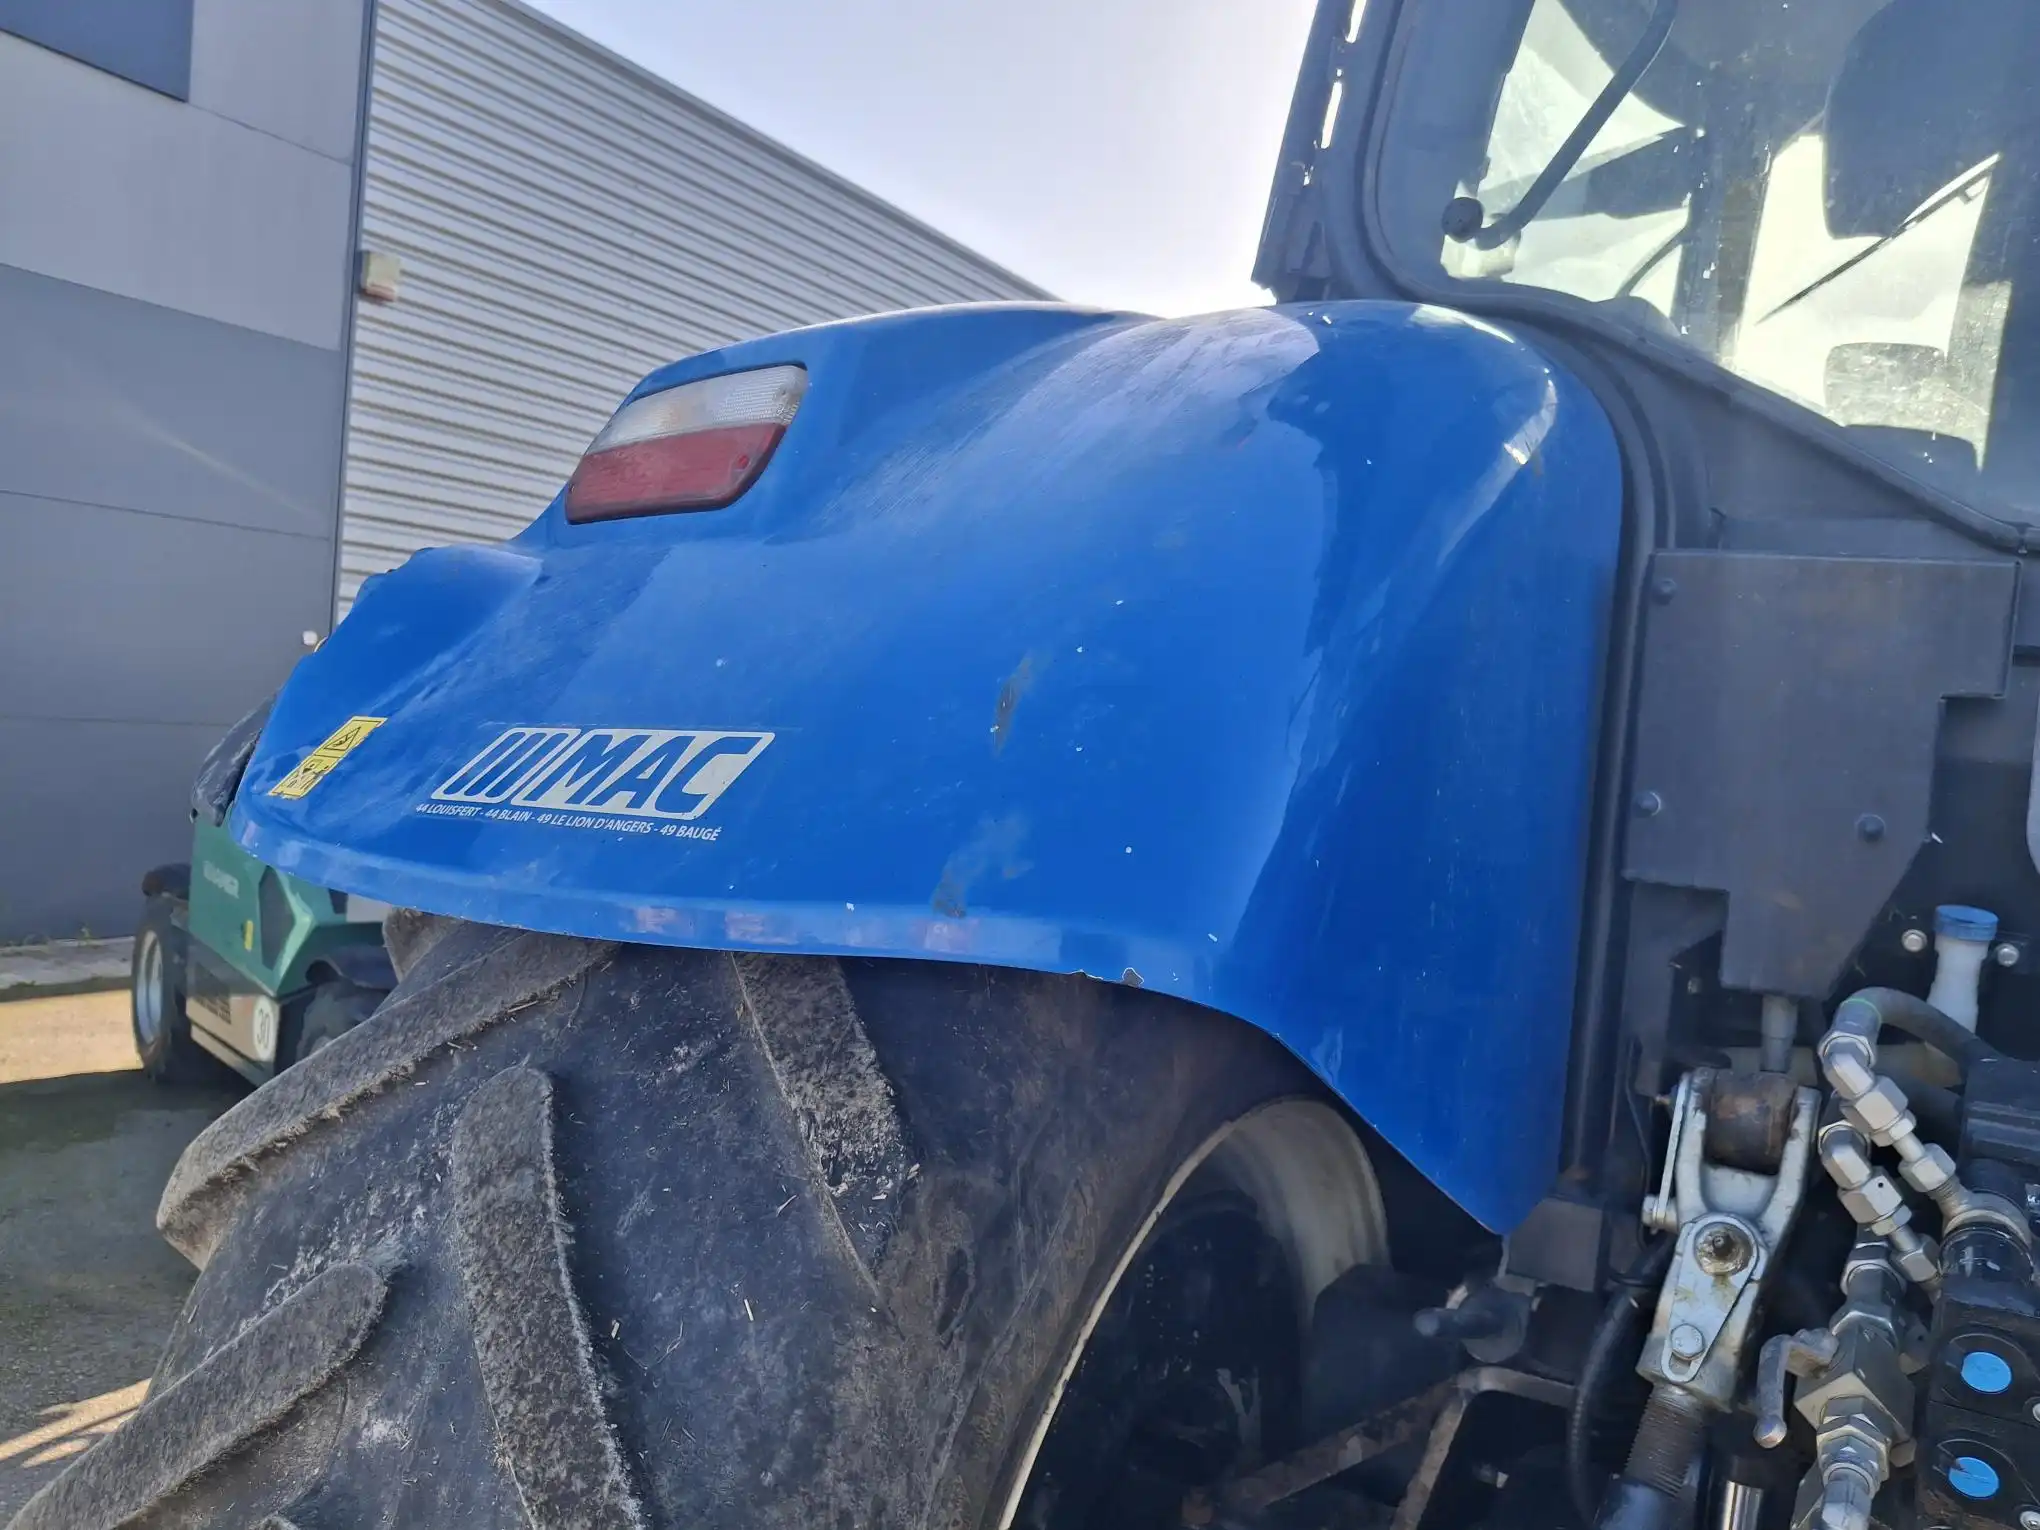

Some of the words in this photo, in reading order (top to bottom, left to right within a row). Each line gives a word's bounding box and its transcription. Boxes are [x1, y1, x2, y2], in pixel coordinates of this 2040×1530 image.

[517, 734, 764, 814] MAC
[415, 803, 429, 813] 44
[426, 804, 483, 817] LOUISFERT
[485, 808, 500, 819] 44
[498, 809, 533, 822] BLAIN
[537, 813, 553, 824] 49
[550, 814, 568, 826] LE
[564, 815, 596, 829] LION
[594, 818, 655, 834] D'ANGERS
[660, 823, 677, 836] 49
[676, 825, 722, 841] BAUGÉ
[256, 1007, 271, 1050] 30
